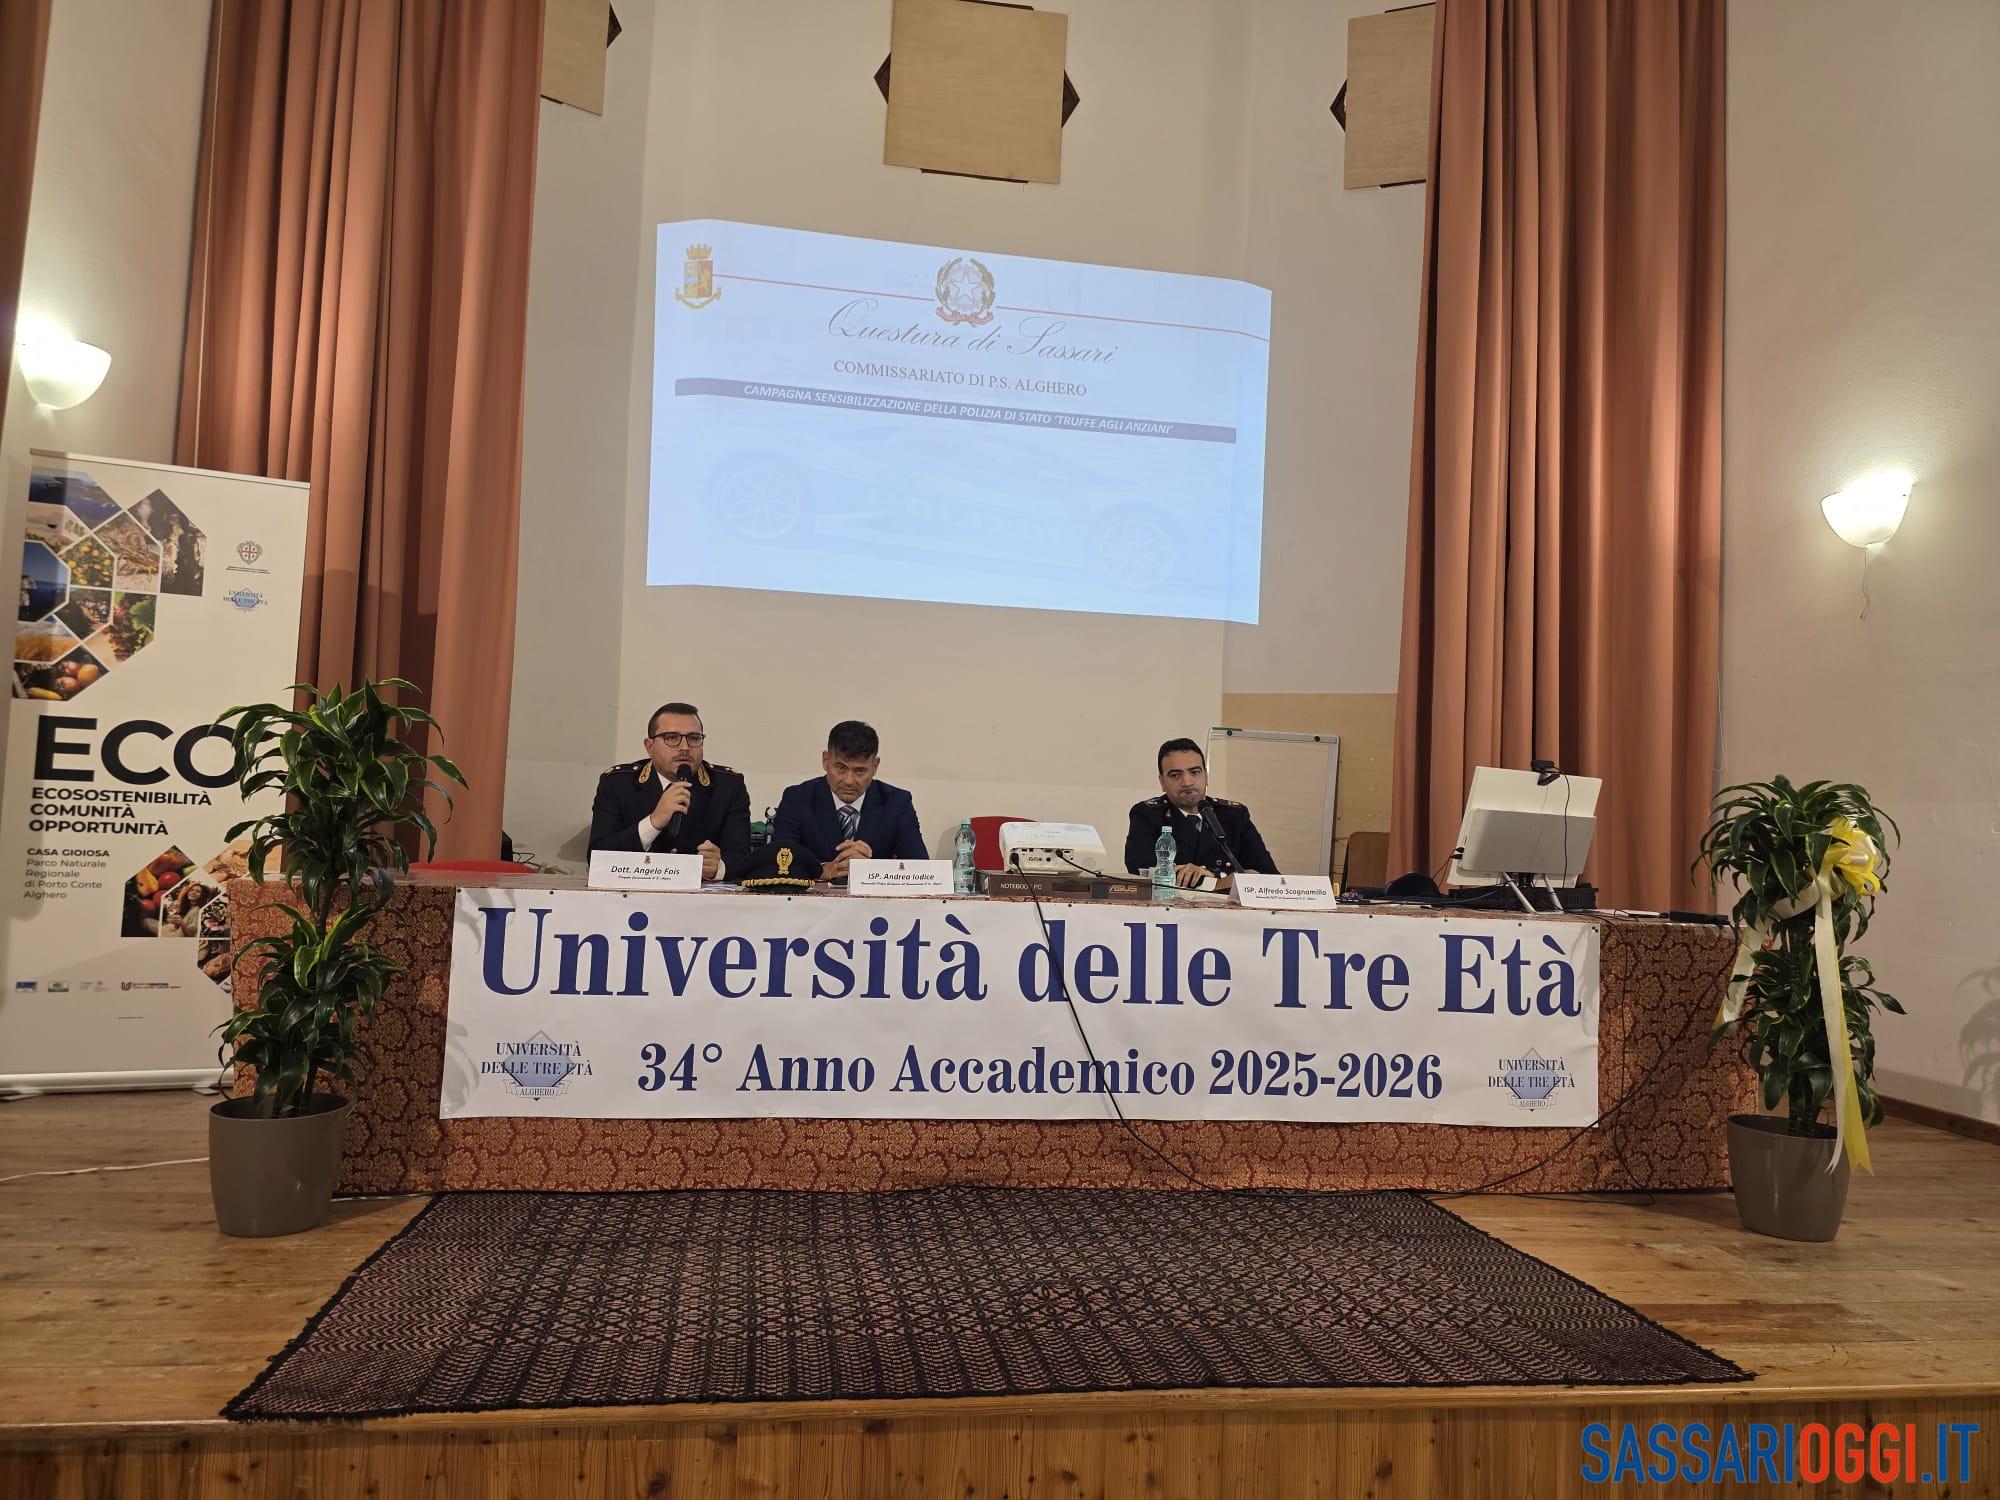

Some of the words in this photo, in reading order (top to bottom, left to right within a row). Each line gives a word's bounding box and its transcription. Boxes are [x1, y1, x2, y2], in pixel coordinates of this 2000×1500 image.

[828, 297, 960, 348] Questura
[967, 325, 1002, 351] di
[1006, 316, 1119, 364] Sassari
[833, 359, 965, 385] COMMISSARIATO
[968, 373, 985, 387] DI
[988, 376, 1012, 390] P.S.
[1014, 379, 1088, 397] ALGHERO
[743, 385, 812, 401] CAMPAGNA
[815, 392, 921, 411] SENSIBILIZZAZIONE
[923, 403, 957, 416] DELLA
[959, 406, 1001, 419] POLIZIA
[1004, 410, 1016, 421] DI
[1018, 412, 1052, 425] STATO
[1099, 420, 1123, 431] AGLI
[34, 715, 241, 788] ECO
[32, 787, 212, 806] ECOSOSTENIBILITÀ
[30, 803, 136, 819] COMUNITÀ
[28, 819, 169, 836] OPPORTUNITÀ
[27, 848, 59, 857] CASA
[62, 849, 110, 857] GIOIOSA
[26, 859, 58, 867] Parco
[60, 860, 107, 869] Naturale
[611, 865, 632, 874] Dott.
[633, 866, 663, 876] Angelo
[664, 867, 681, 876] Fois
[25, 869, 81, 879] Regionale
[868, 873, 882, 881] ISP.
[883, 873, 911, 881] Andrea
[912, 873, 935, 881] Iodice
[24, 880, 35, 888] di
[37, 881, 68, 889] Porto
[70, 881, 103, 889] Conte
[1000, 882, 1033, 890] NOTEBOO
[1108, 884, 1138, 893] ASUS
[1244, 886, 1257, 895] ISP.
[1258, 887, 1284, 896] Alfredo
[23, 890, 68, 900] Alghero
[478, 907, 988, 1001] Università
[1018, 918, 1232, 1006] delle
[1261, 926, 1411, 1013] Tre
[1437, 933, 1583, 1018] Età
[496, 1041, 582, 1056] UNIVERSITÀ
[481, 1061, 528, 1074] DELLE
[532, 1062, 561, 1075] TRE
[566, 1060, 593, 1075] ETÀ
[1499, 1057, 1565, 1070] UNIVERSITÀ
[637, 1042, 724, 1093] 34°
[736, 1043, 876, 1094] Anno
[889, 1044, 1196, 1096] Accademico
[1208, 1048, 1443, 1100] 2025-2026
[1487, 1076, 1526, 1088] DELLE
[1527, 1076, 1549, 1088] TRE
[1553, 1073, 1576, 1088] ETÀ
[519, 1088, 555, 1096] ALGHERO
